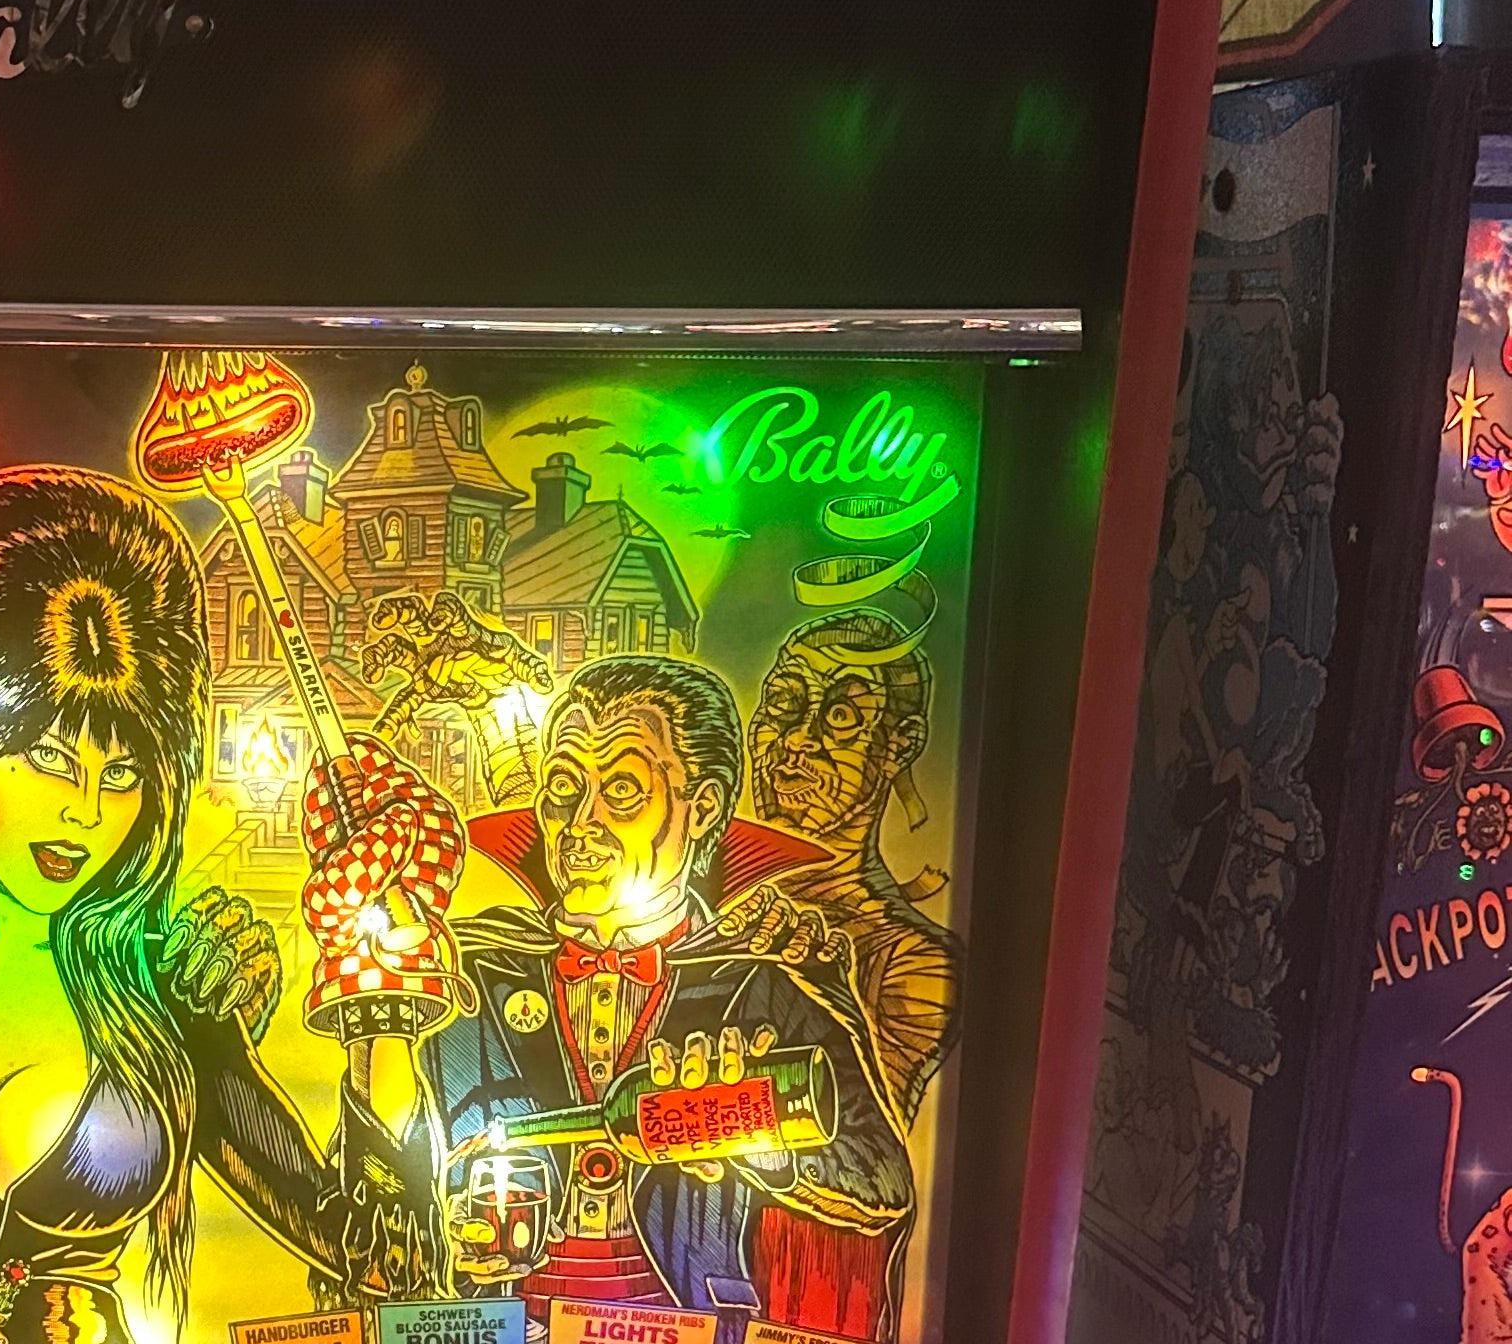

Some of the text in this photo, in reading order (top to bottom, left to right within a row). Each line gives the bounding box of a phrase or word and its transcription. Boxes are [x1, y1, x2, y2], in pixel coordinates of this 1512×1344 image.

[704, 386, 948, 504] Bally
[288, 635, 330, 716] SMARKIE
[1370, 885, 1512, 993] ACKPO
[510, 1008, 546, 1030] GAVE!
[642, 1093, 675, 1162] PLASMA
[663, 1108, 688, 1146] RED
[703, 1097, 723, 1150] VINTAGE
[720, 1103, 742, 1141] 1931
[752, 1101, 765, 1131] FROM
[686, 1121, 705, 1153] TYPE
[245, 1317, 350, 1344] HANDBURGER
[396, 1318, 506, 1334] BLOOD SAUSAGE
[419, 1307, 482, 1321] SCHWEI'S
[631, 1307, 676, 1325] BROKEN
